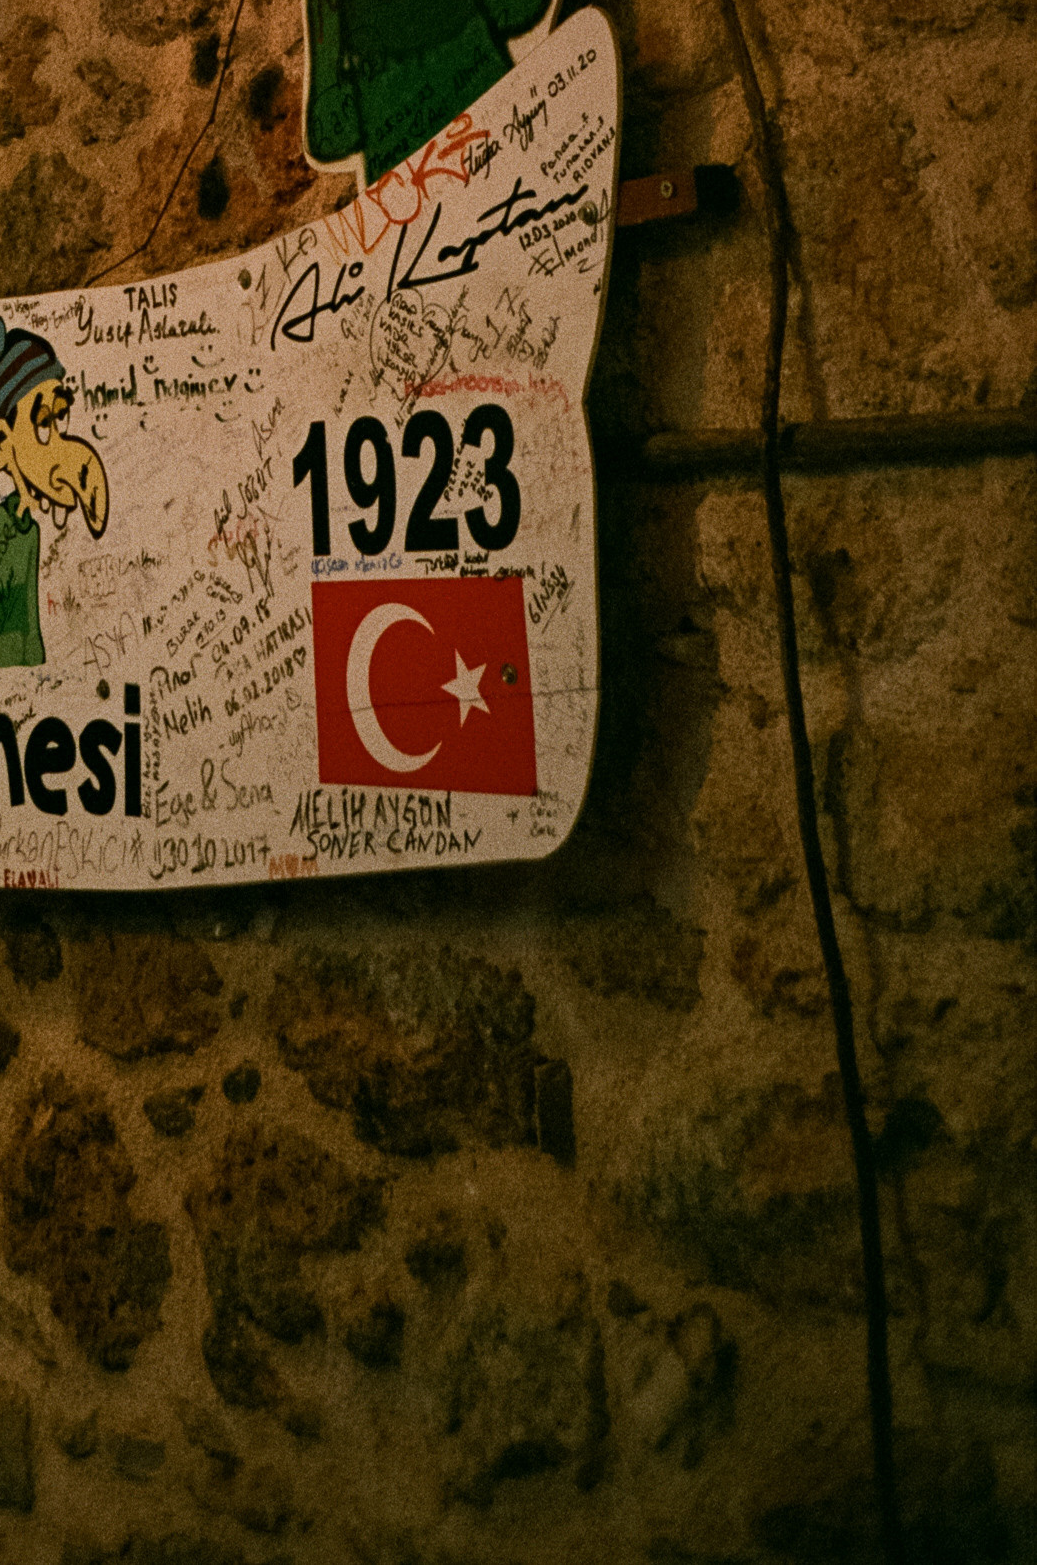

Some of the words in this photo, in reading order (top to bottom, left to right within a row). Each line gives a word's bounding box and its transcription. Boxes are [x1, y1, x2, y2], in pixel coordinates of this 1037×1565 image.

[123, 283, 178, 312] TALIS
[292, 402, 521, 557] 1923
[166, 610, 201, 658] BURAK
[162, 694, 213, 742] Melih
[155, 780, 198, 829] Ege
[302, 828, 377, 862] SONER
[386, 828, 483, 857] CANDAN
